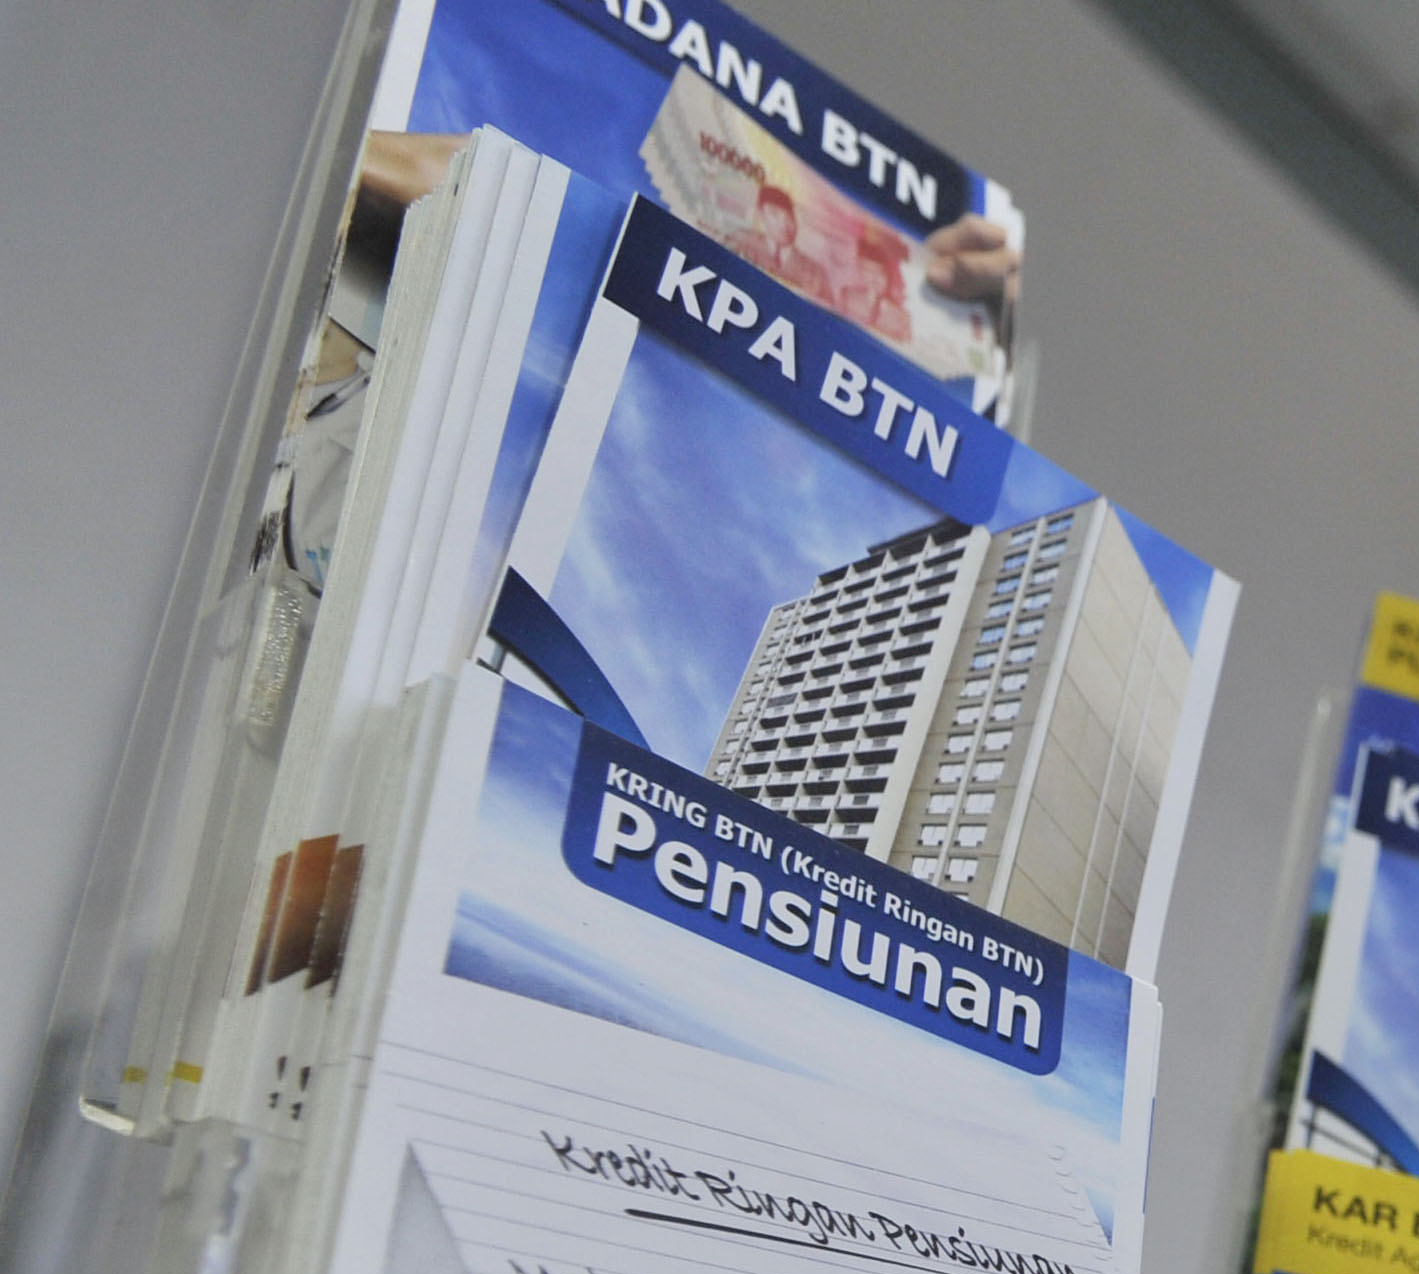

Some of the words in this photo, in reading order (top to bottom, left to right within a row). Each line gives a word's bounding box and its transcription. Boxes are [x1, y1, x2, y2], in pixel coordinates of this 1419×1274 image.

[602, 0, 803, 135] DANA
[820, 108, 938, 221] BTN
[656, 247, 798, 383] KPA
[818, 351, 960, 479] BTN
[592, 786, 1044, 1052] Pensiunan
[605, 761, 707, 829] KRING
[713, 814, 774, 859] BTN
[780, 834, 877, 909] (Kredit
[883, 889, 975, 955] Ringan
[982, 932, 1045, 986] BTN)
[541, 1131, 701, 1203] Kredit
[695, 1169, 876, 1247] Ringan
[1306, 1224, 1385, 1263] Kredit
[1311, 1185, 1399, 1236] KAR
